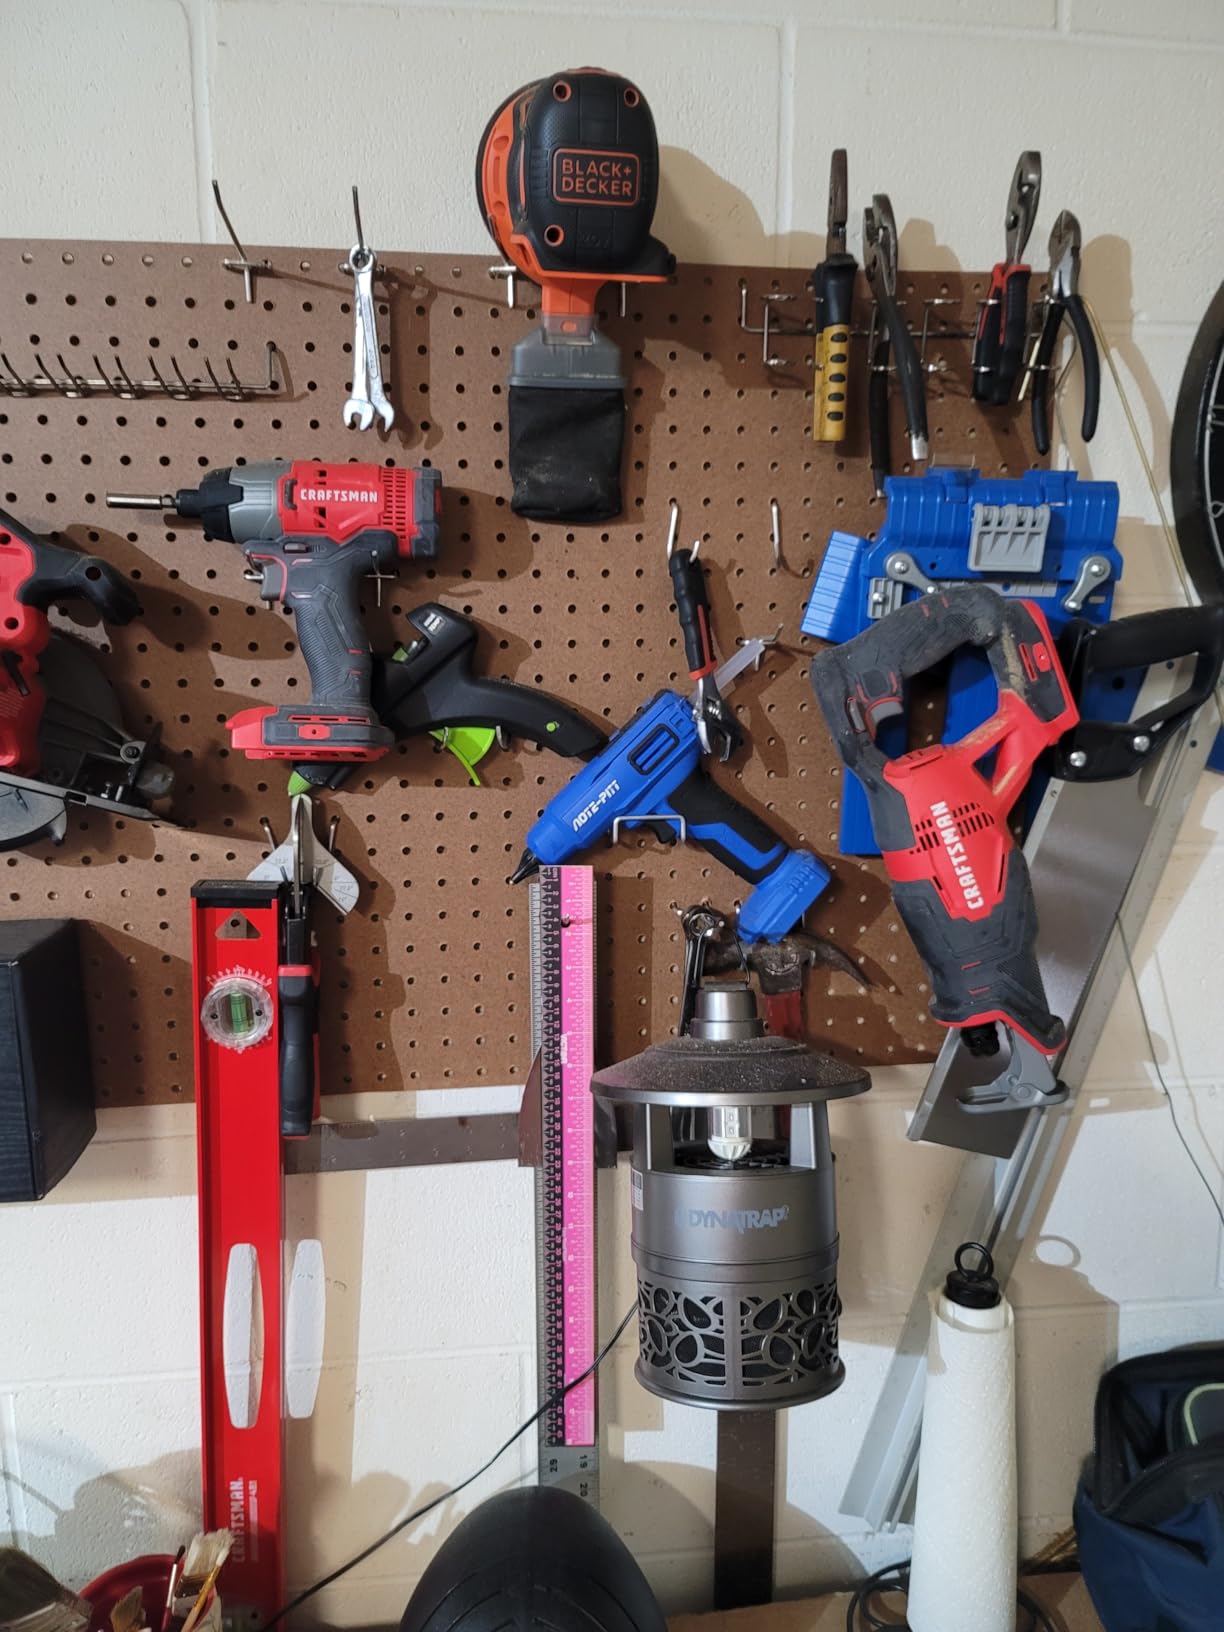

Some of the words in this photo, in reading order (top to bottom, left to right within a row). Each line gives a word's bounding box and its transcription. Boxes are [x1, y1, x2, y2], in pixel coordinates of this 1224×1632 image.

[561, 178, 632, 196] DECKER
[300, 488, 378, 503] CRAFTSMAN
[929, 800, 984, 910] CRAFTSMAN
[687, 1207, 786, 1232] DYNATRAP
[580, 1454, 588, 1469] 19
[580, 1482, 588, 1497] 20
